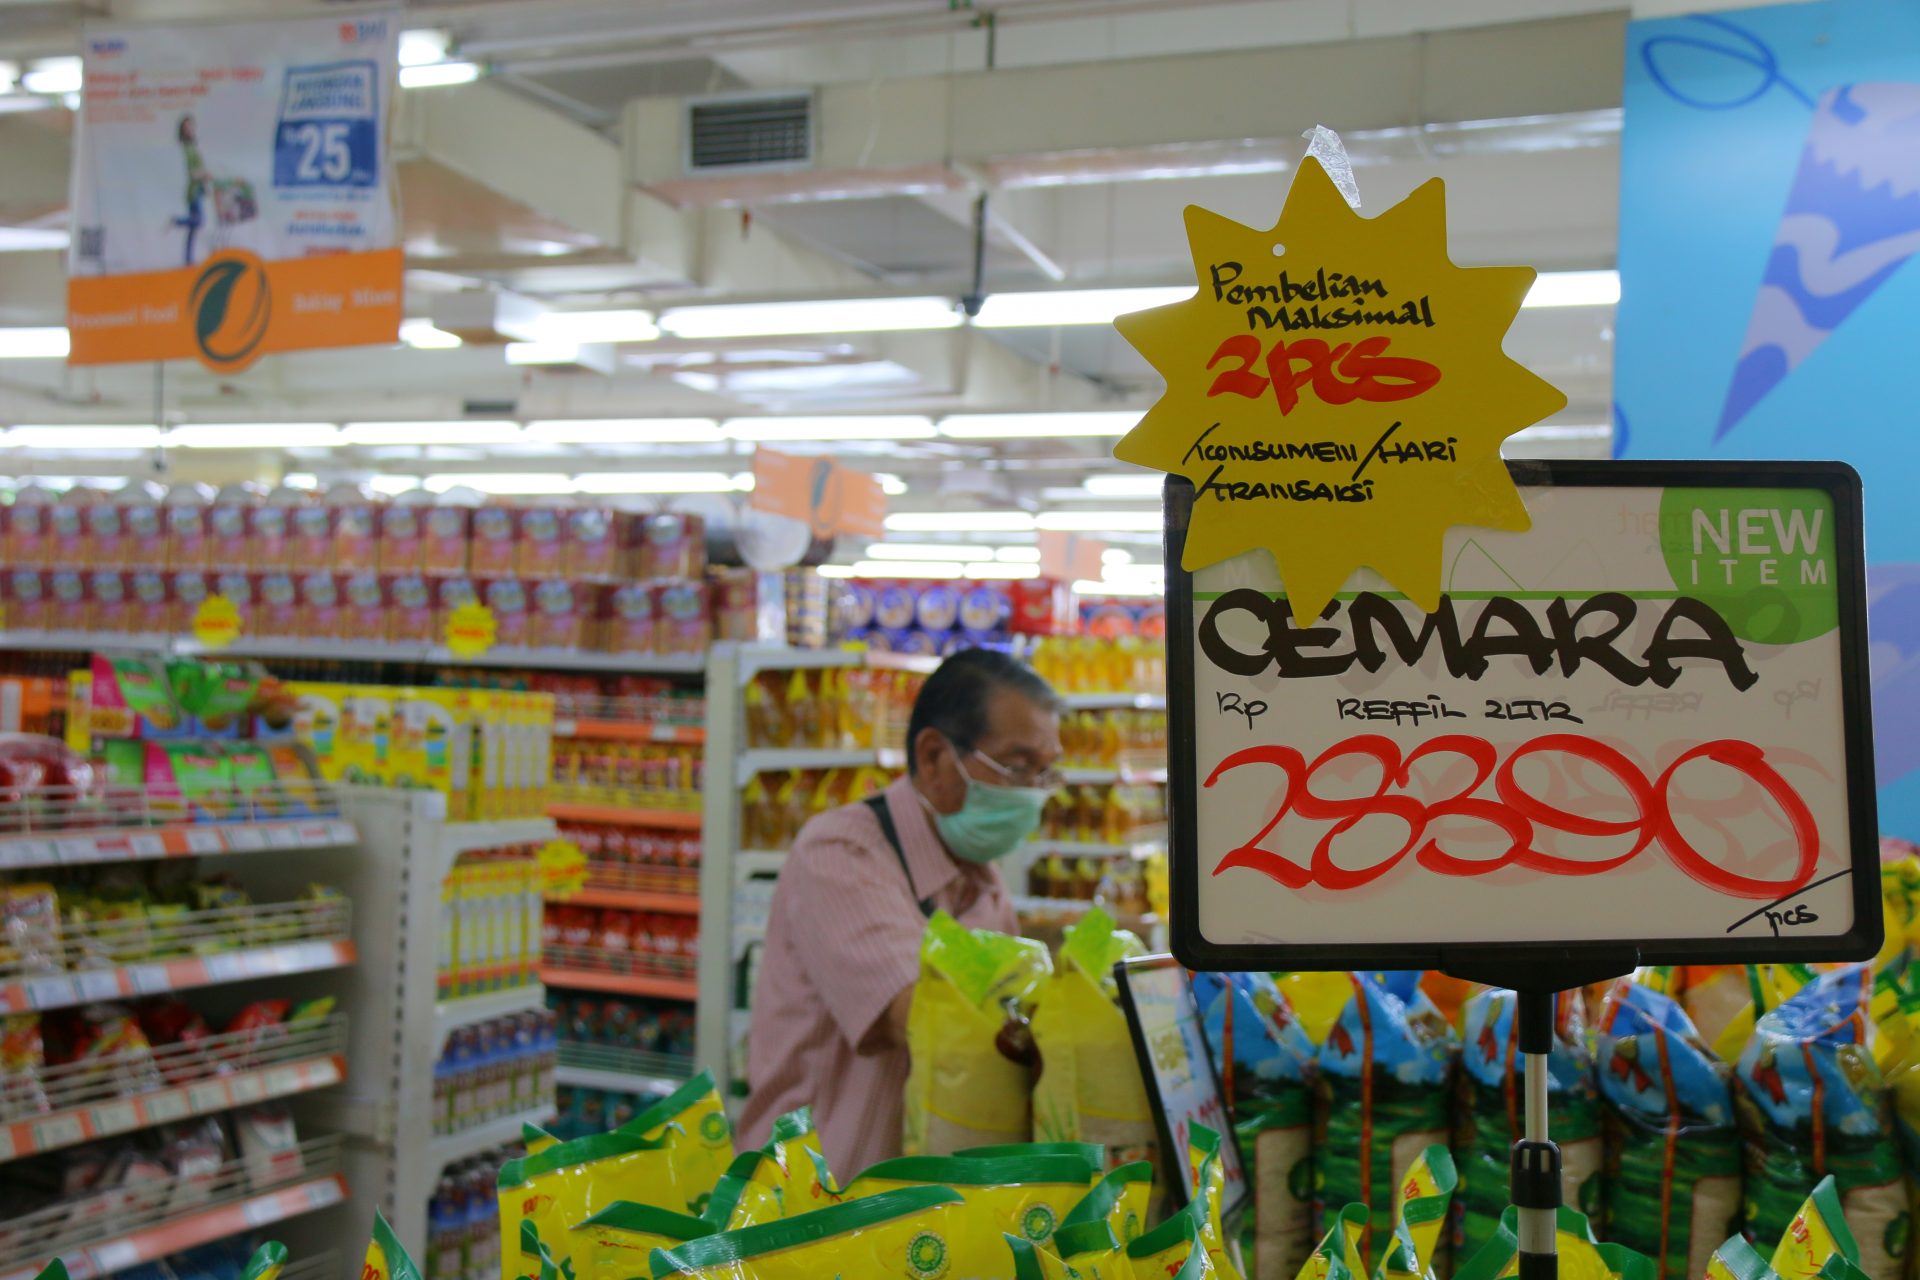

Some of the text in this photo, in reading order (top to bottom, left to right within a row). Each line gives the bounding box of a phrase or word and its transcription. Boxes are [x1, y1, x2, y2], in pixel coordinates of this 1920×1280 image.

[297, 123, 351, 182] 25
[1210, 261, 1388, 305] Pembelian
[1247, 296, 1436, 332] Maksimal
[1691, 508, 1824, 555] NEW
[1691, 559, 1828, 585] ITEM
[1199, 588, 1760, 691] CEMARA
[1216, 691, 1268, 730] Rp
[1203, 733, 1820, 900] 28390
